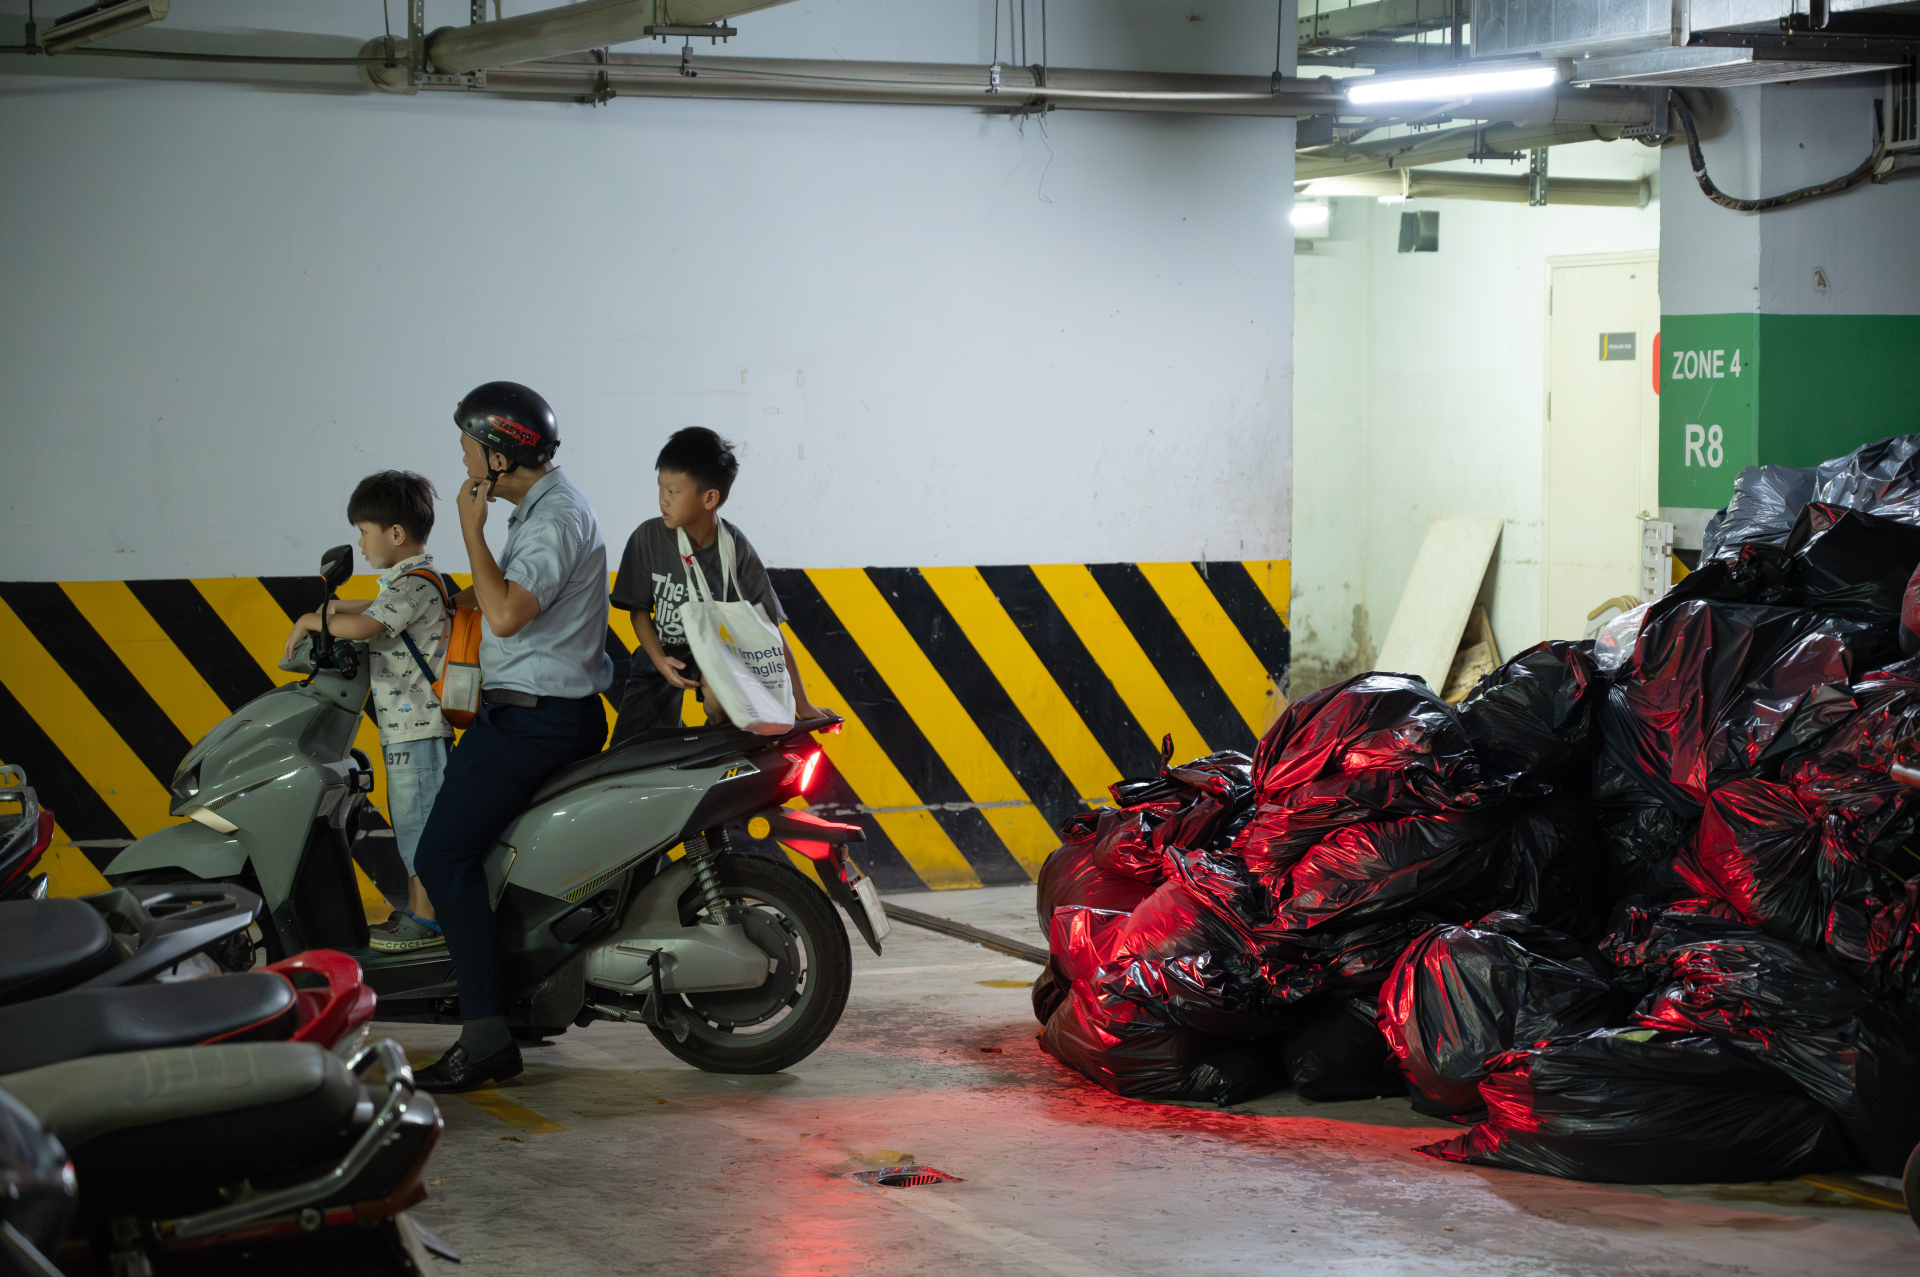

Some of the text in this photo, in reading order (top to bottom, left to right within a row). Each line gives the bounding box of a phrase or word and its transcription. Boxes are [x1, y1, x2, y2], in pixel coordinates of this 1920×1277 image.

[1672, 349, 1742, 379] ZONE 4
[1684, 424, 1724, 468] R8
[652, 572, 684, 602] The
[385, 941, 422, 950] crocs
